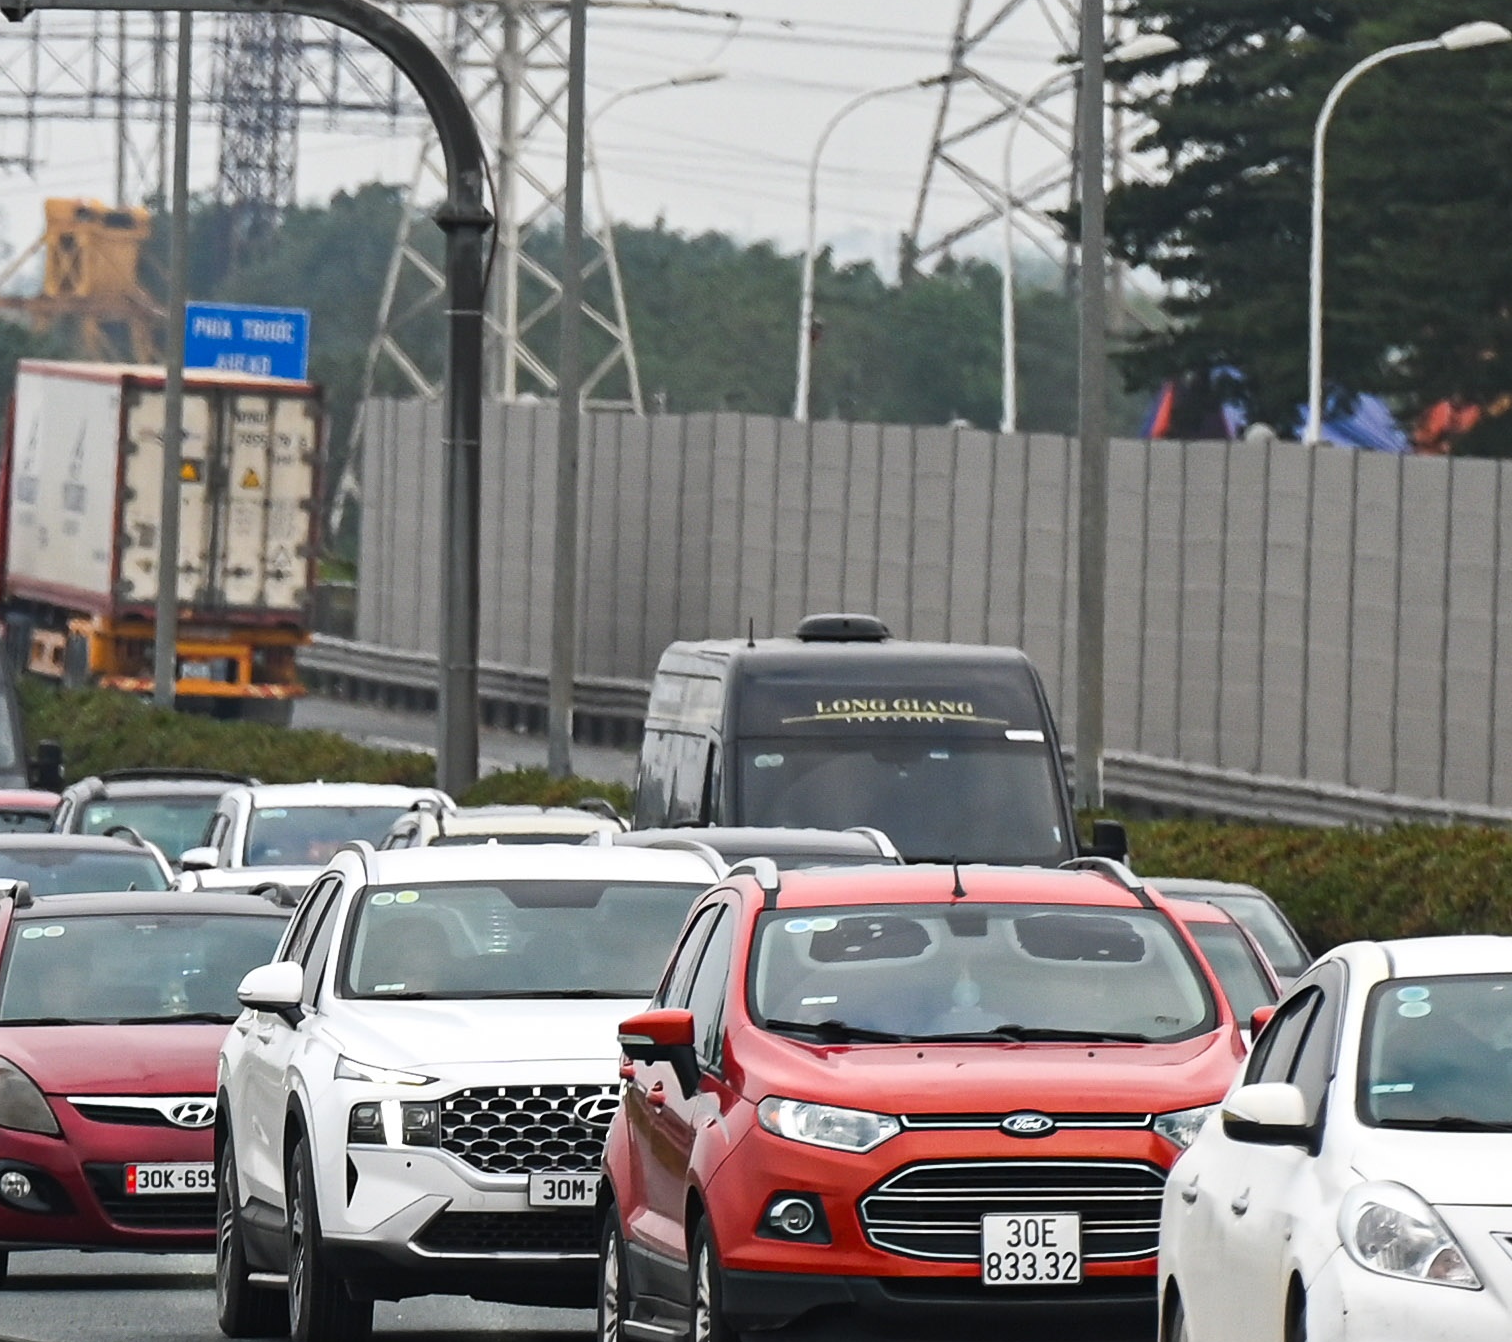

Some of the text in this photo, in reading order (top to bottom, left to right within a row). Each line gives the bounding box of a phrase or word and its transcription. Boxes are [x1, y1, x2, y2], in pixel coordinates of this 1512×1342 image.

[815, 697, 975, 715] LONG GIANG
[543, 1179, 602, 1200] 30M-
[1006, 1218, 1058, 1248] 30E
[986, 1251, 1078, 1281] 833.32
